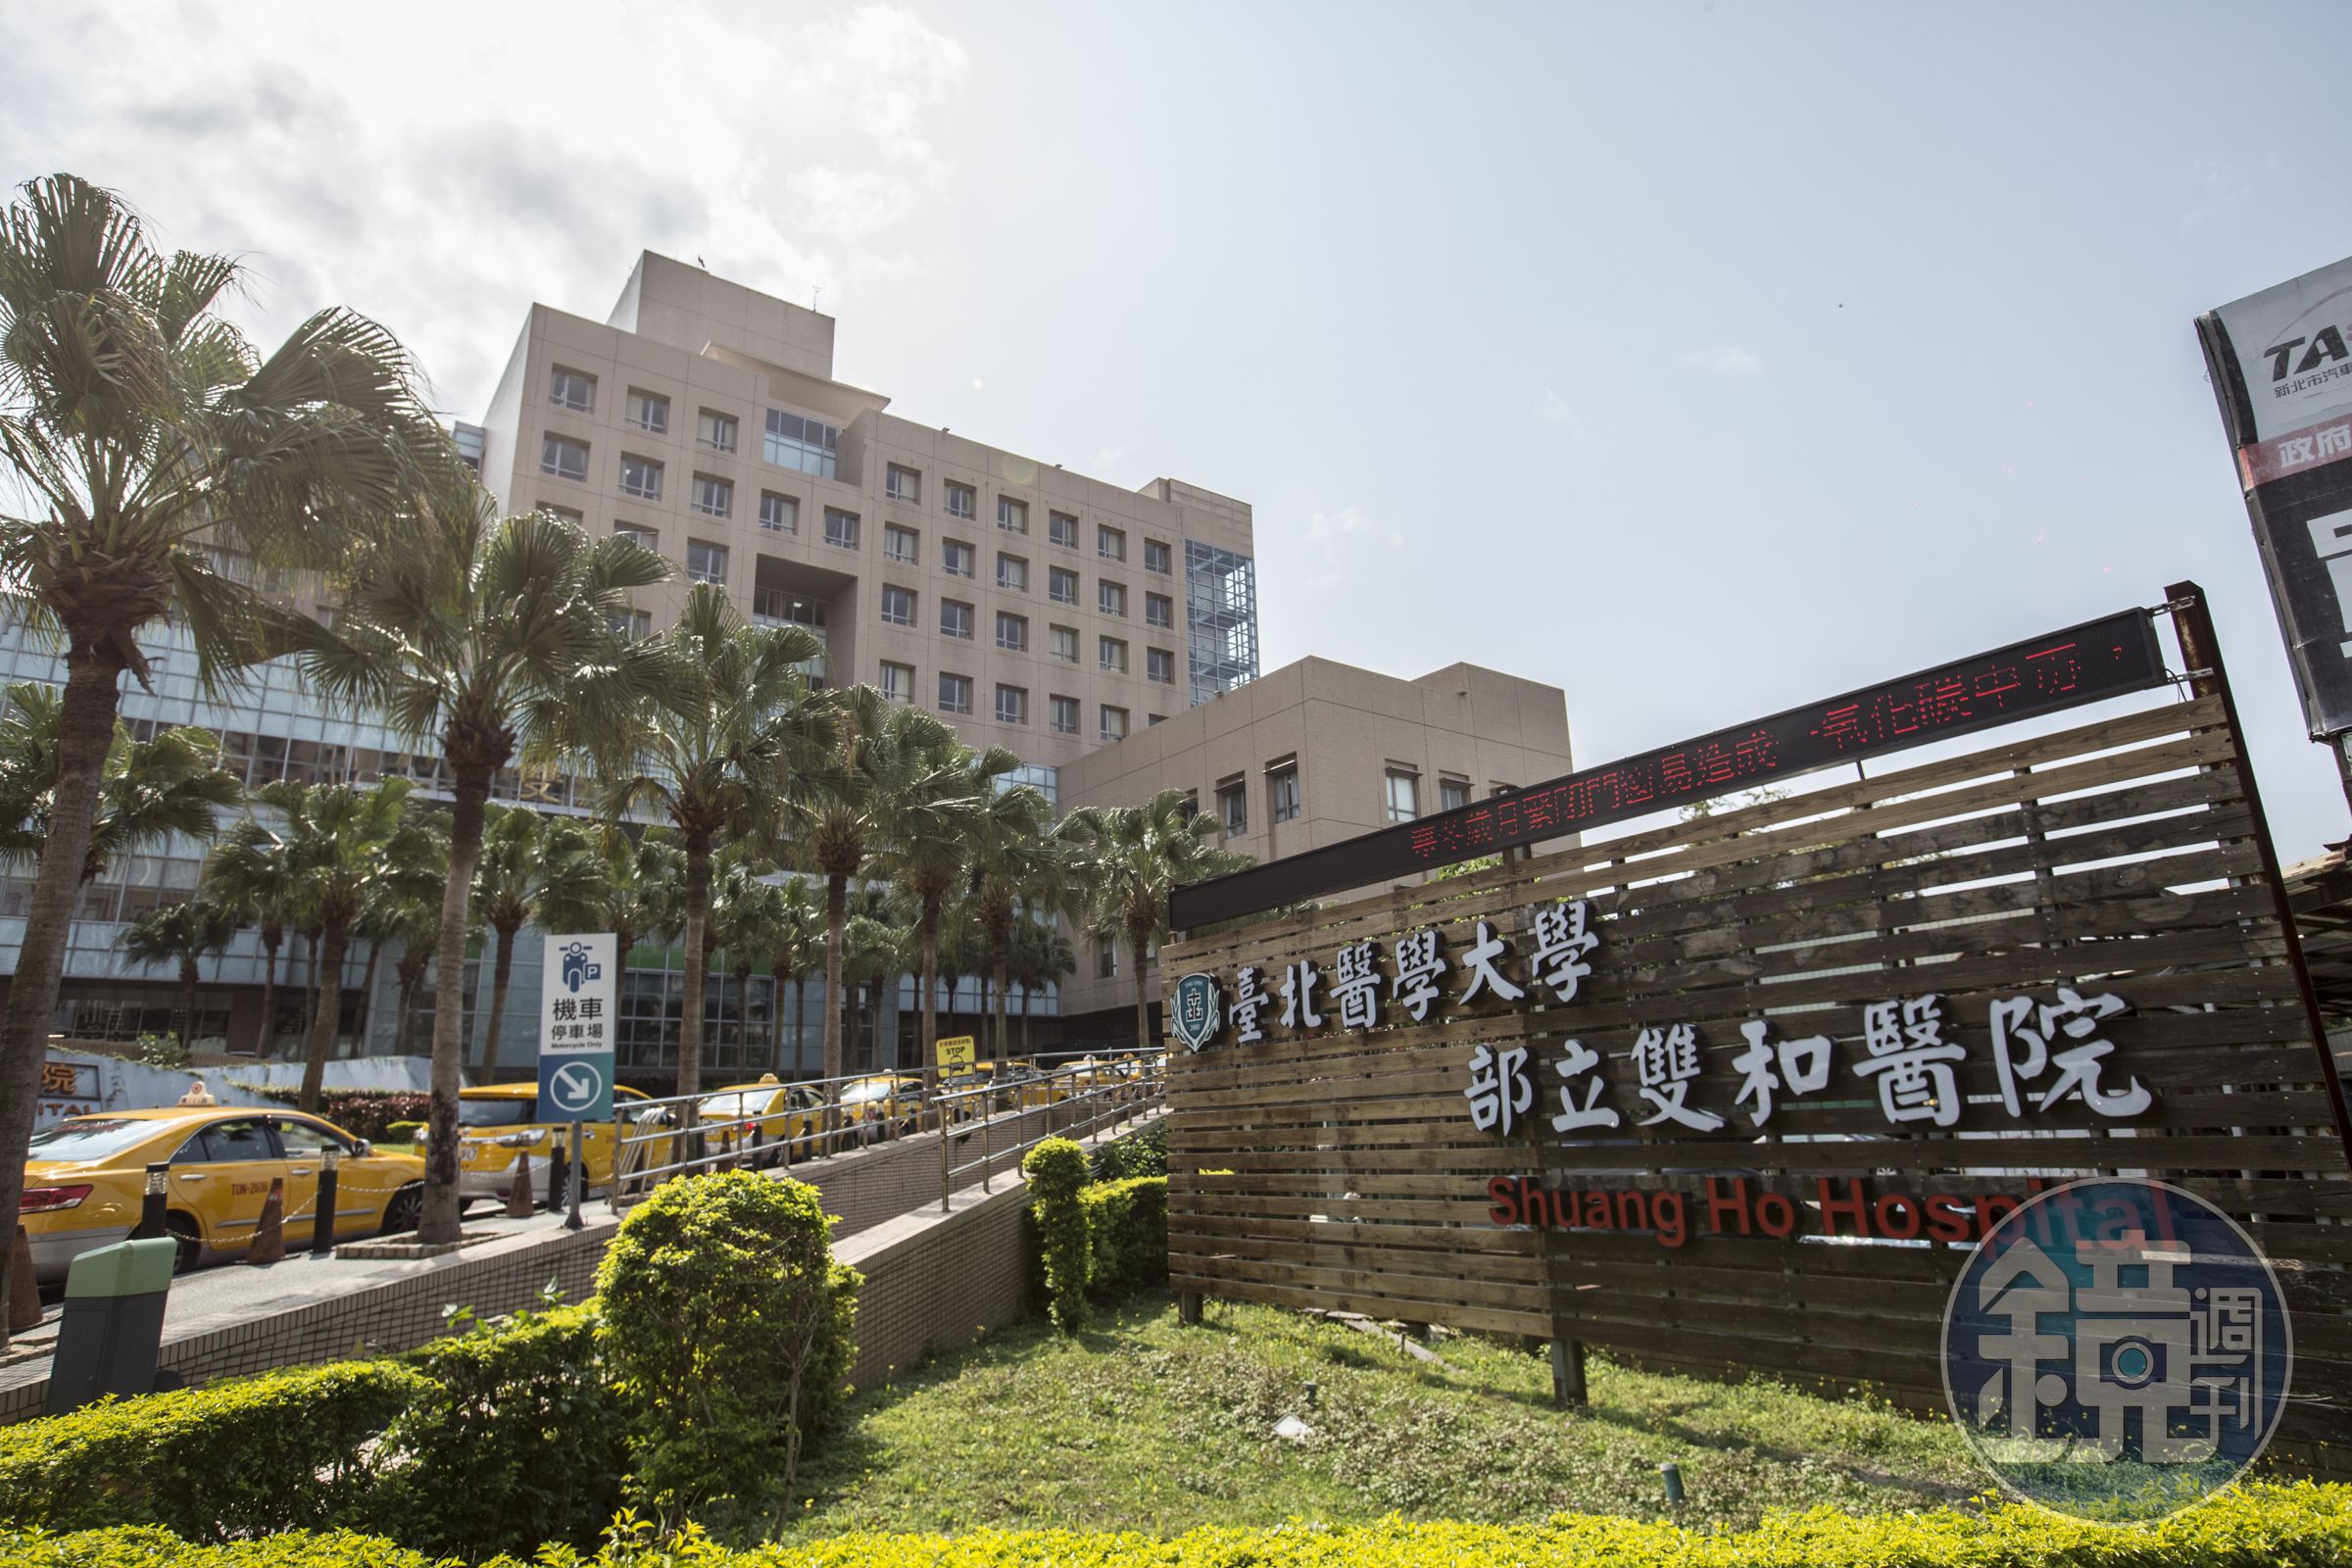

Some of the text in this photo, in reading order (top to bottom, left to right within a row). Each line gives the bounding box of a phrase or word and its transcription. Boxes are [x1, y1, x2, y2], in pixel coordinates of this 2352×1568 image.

[2278, 423, 2352, 468] 政府
[1228, 900, 1599, 1044] 臺北醫學大學
[551, 1022, 604, 1041] 停車場
[552, 997, 604, 1021] 機車
[946, 1046, 965, 1055] STOP
[1463, 987, 2153, 1138] 部立雙和醫院
[1487, 1176, 2180, 1262] Shuang Ho Hospital
